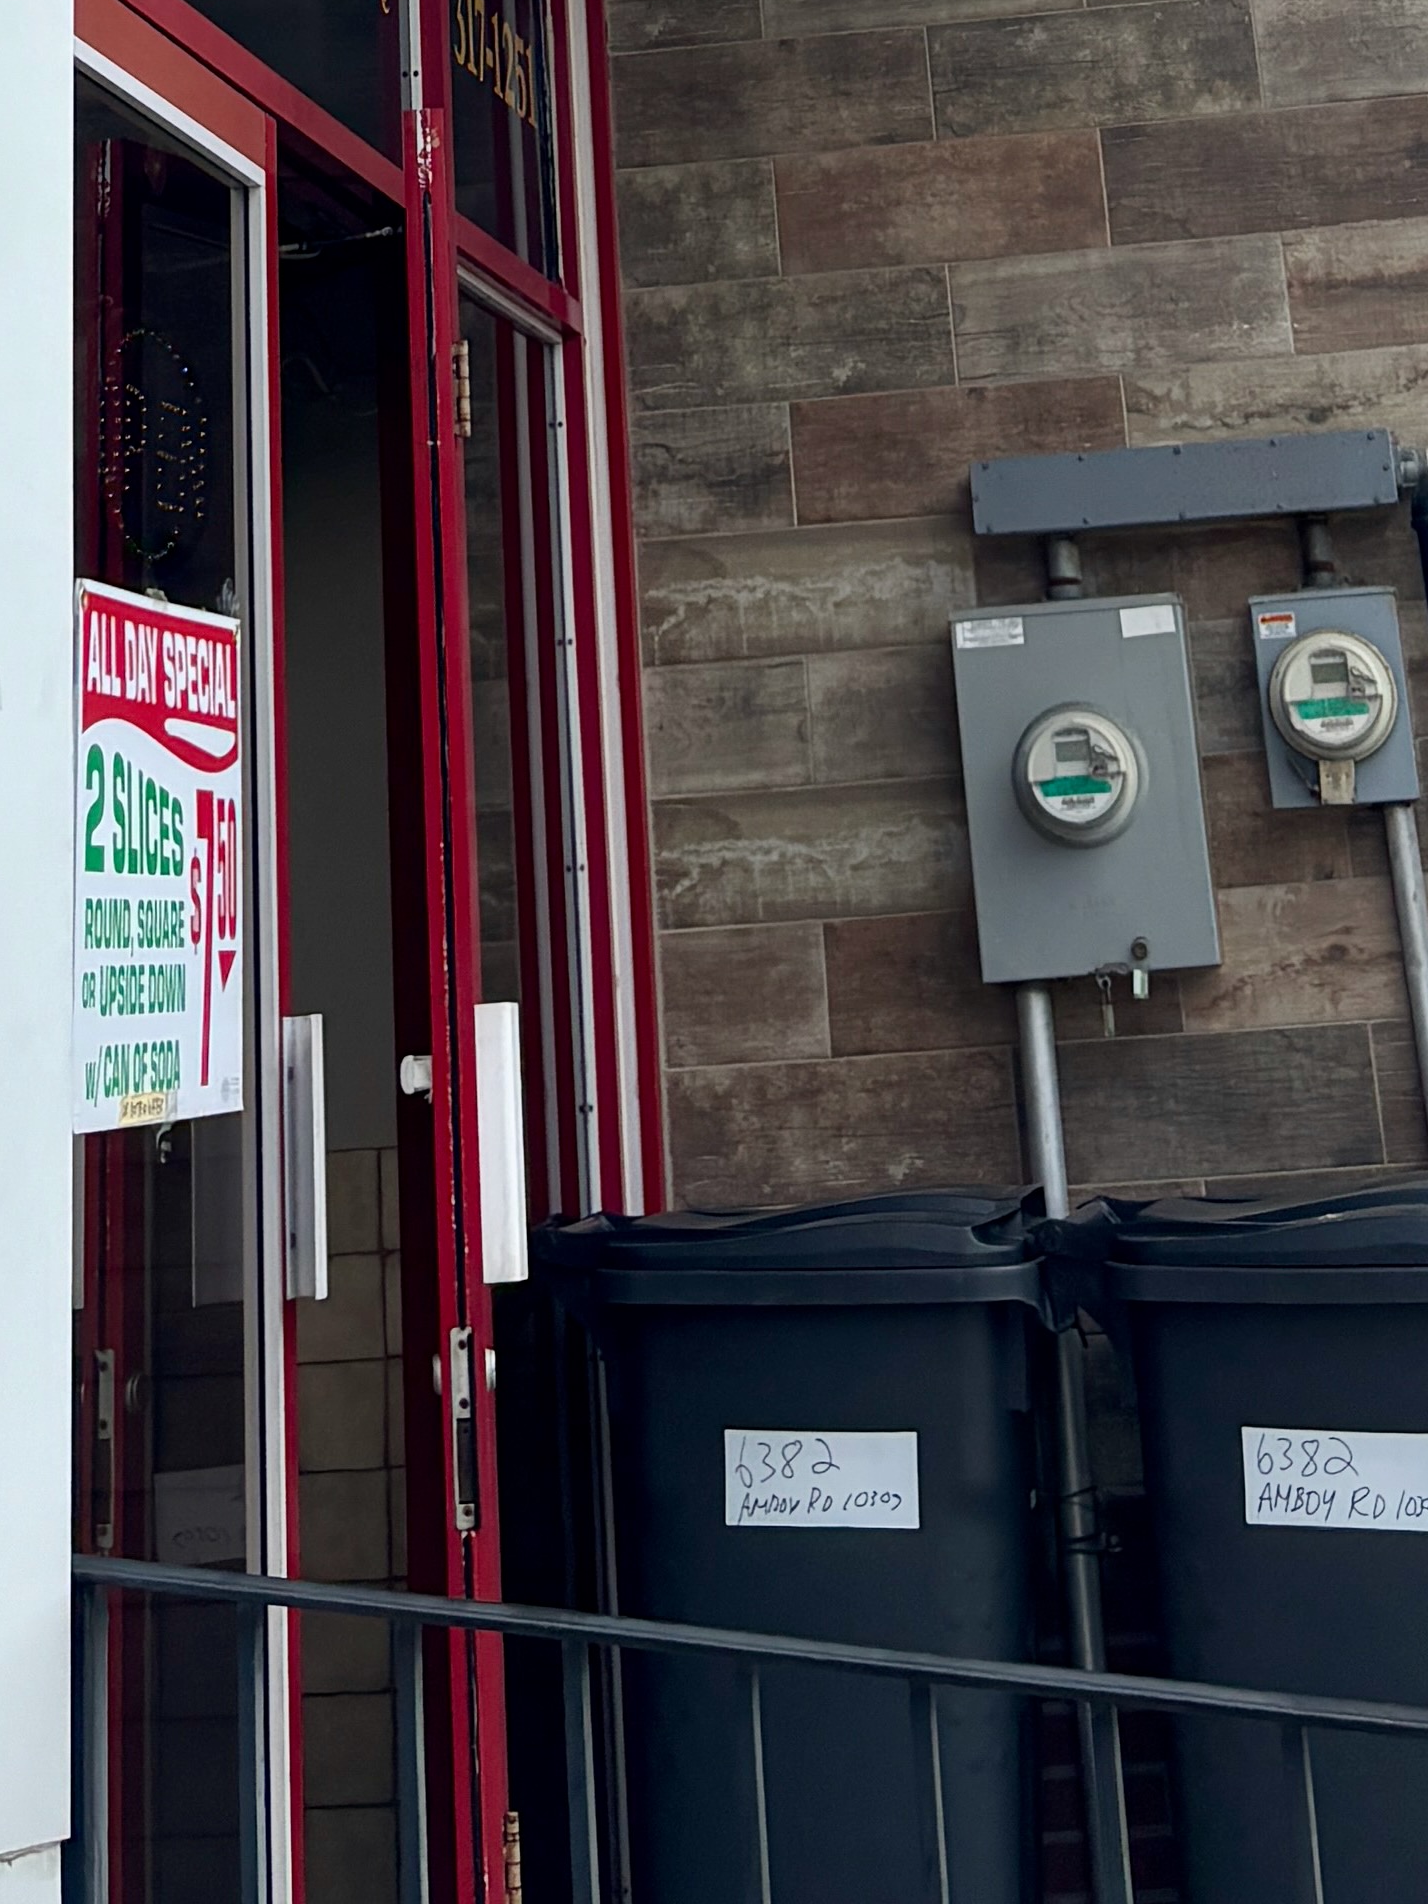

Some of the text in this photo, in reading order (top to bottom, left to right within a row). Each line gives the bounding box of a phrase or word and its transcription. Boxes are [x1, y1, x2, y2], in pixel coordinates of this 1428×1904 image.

[87, 610, 237, 720] ALL DAY SPECIAL
[84, 743, 185, 877] 2 SLICES
[84, 897, 185, 958] ROUND, SQUARE
[81, 963, 186, 1017] OR UPSIDE DOWN
[103, 1043, 131, 1098] CAN
[133, 1042, 148, 1093] OF
[150, 1040, 180, 1092] SODA
[735, 1435, 841, 1489] 6382
[1257, 1432, 1359, 1478] 6382
[807, 1486, 834, 1514] RD
[1257, 1482, 1337, 1524] AMBOY
[1348, 1486, 1386, 1520] RD
